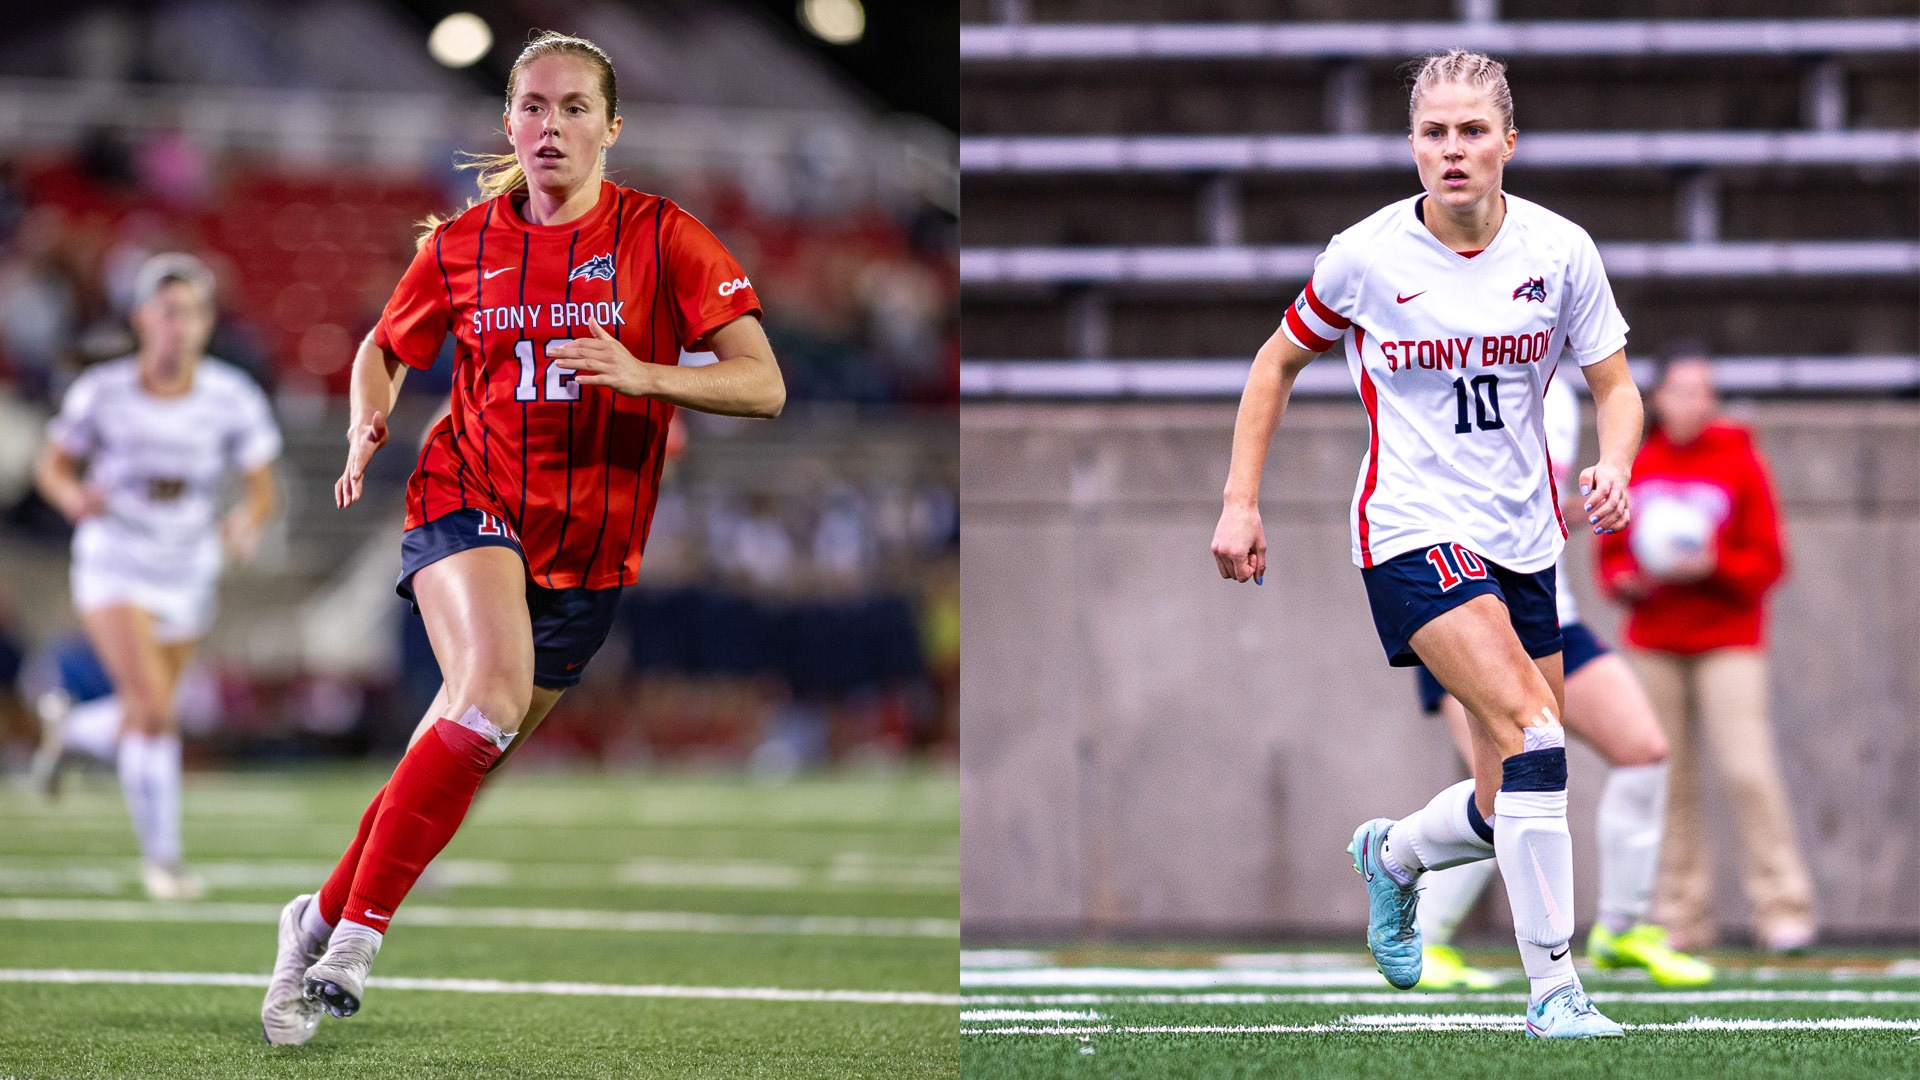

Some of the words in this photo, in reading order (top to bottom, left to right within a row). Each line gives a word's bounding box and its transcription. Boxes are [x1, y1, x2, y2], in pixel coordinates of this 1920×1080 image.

[718, 276, 753, 297] CAA
[472, 304, 542, 335] STONY
[550, 301, 626, 327] BROOK
[1381, 336, 1474, 372] STONY
[1481, 326, 1556, 367] BROOK
[1452, 373, 1505, 434] 10
[477, 508, 521, 546] 1
[1426, 541, 1487, 592] 10
